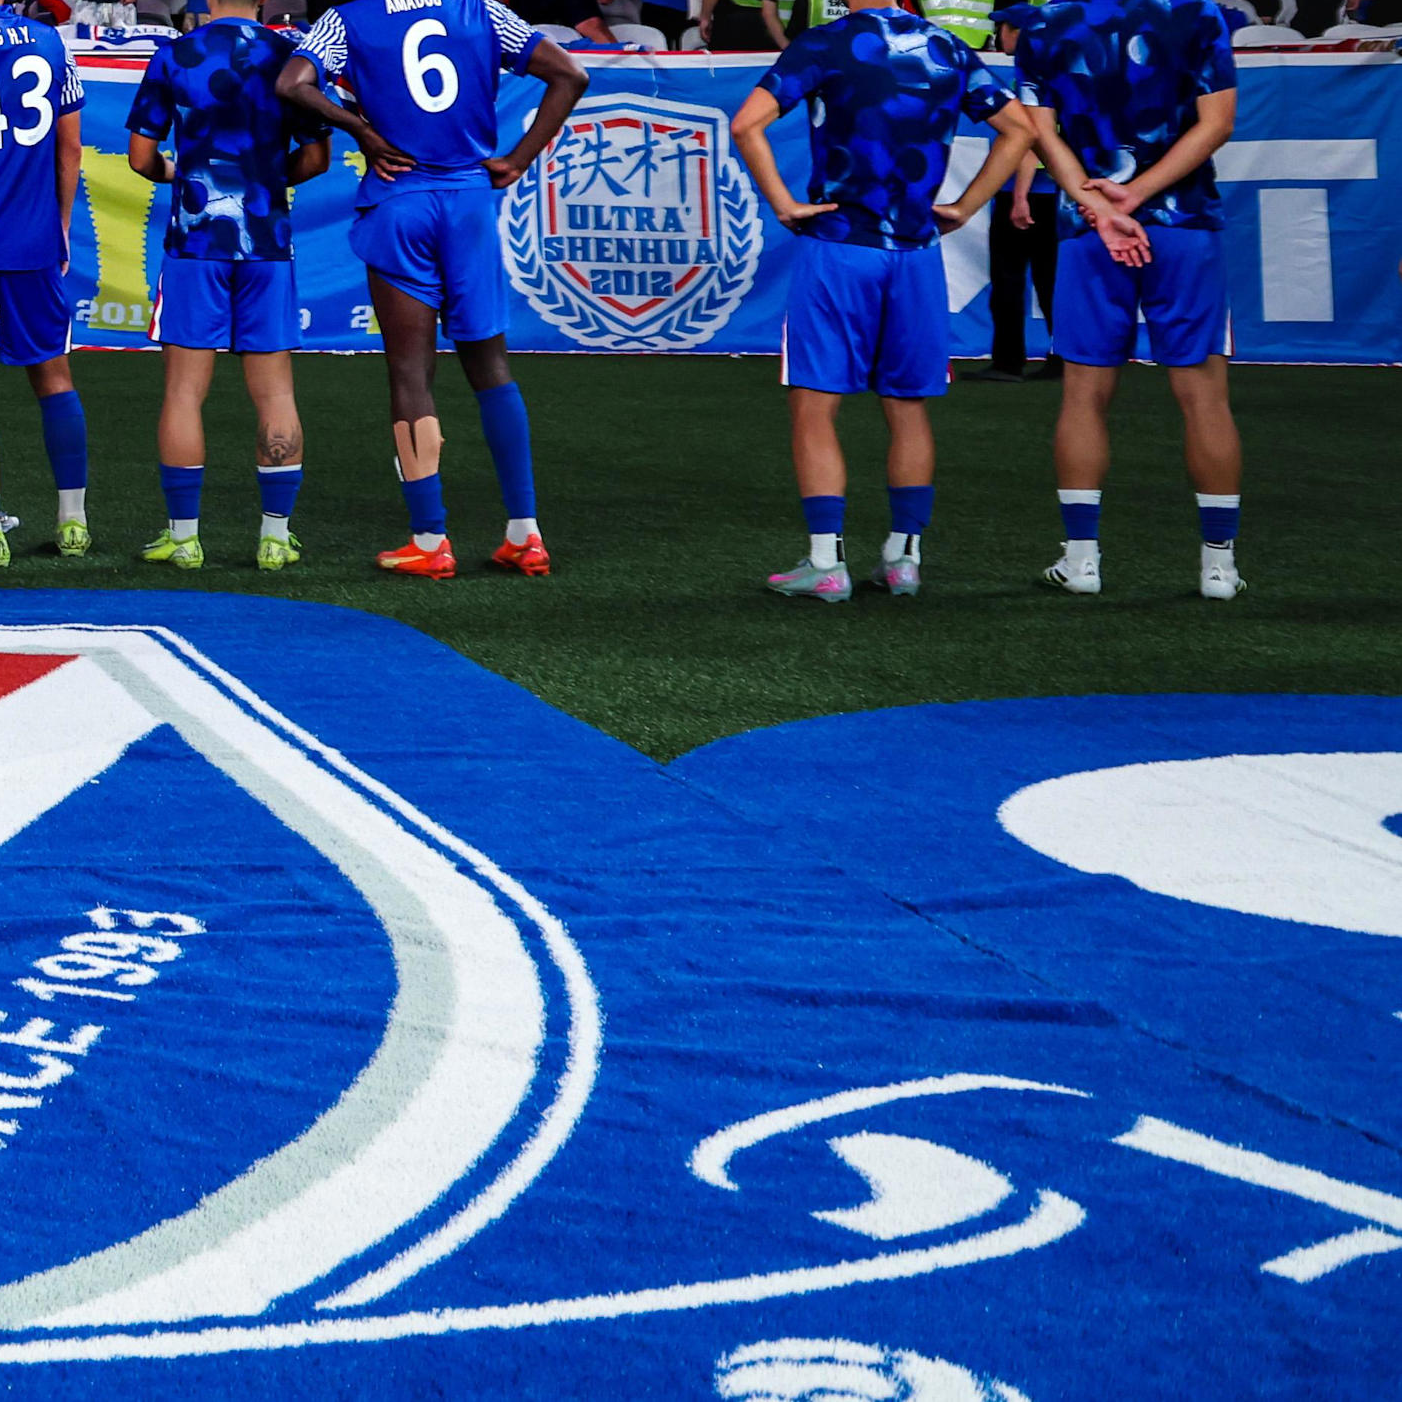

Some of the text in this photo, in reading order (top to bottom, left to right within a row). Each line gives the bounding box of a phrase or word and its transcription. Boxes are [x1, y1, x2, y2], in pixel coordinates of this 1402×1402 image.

[9, 26, 36, 46] H.Y.
[402, 18, 460, 113] 6
[548, 120, 710, 204] 铁杆
[544, 236, 719, 265] SHENHUA
[590, 268, 676, 297] 2012
[75, 298, 153, 327] 201
[12, 902, 207, 1001] 1993
